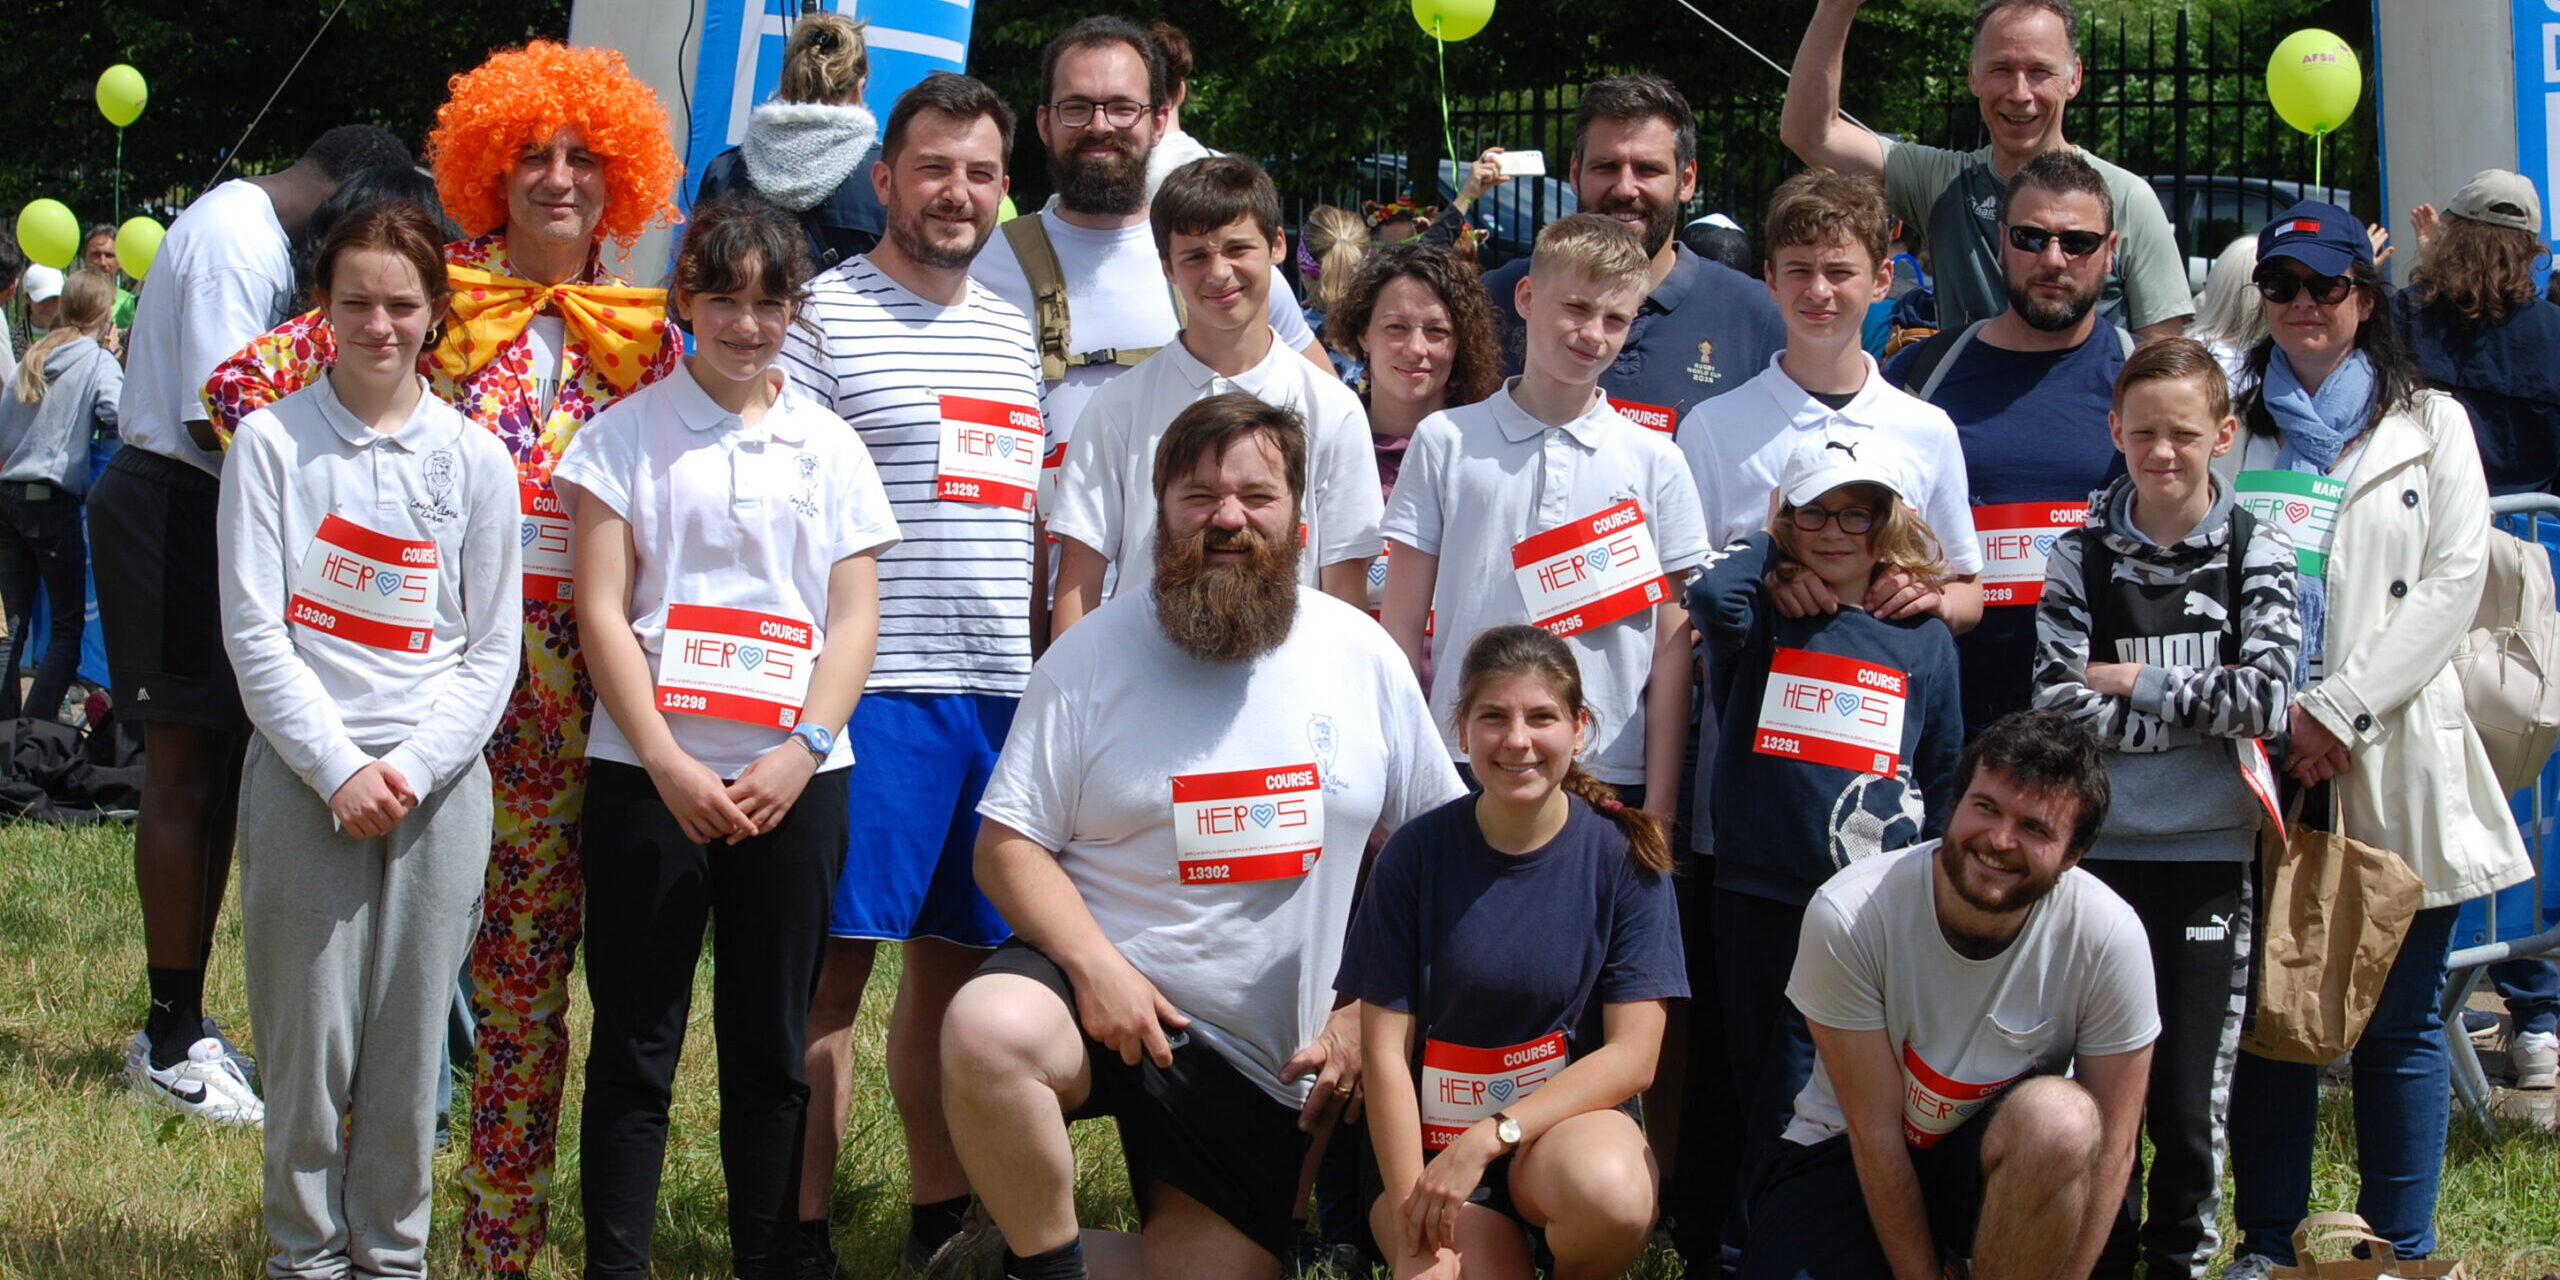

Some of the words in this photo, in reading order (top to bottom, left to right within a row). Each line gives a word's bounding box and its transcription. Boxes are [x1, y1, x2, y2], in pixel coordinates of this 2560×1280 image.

[1009, 411, 1041, 430] COURSE
[1619, 407, 1669, 428] COURSE
[944, 481, 980, 497] 13292
[1593, 507, 1638, 534] COURSE
[402, 547, 436, 563] COURSE
[1983, 588, 2012, 602] 3289
[294, 604, 336, 629] 13303
[760, 621, 808, 644] COURSE
[1857, 669, 1901, 692] COURSE
[663, 693, 707, 710] 13298
[1761, 735, 1800, 753] 13291
[1265, 771, 1314, 789] COURSE
[1187, 865, 1230, 880] 13302
[2186, 926, 2224, 941] PUMA
[1504, 1041, 1556, 1066] COURSE
